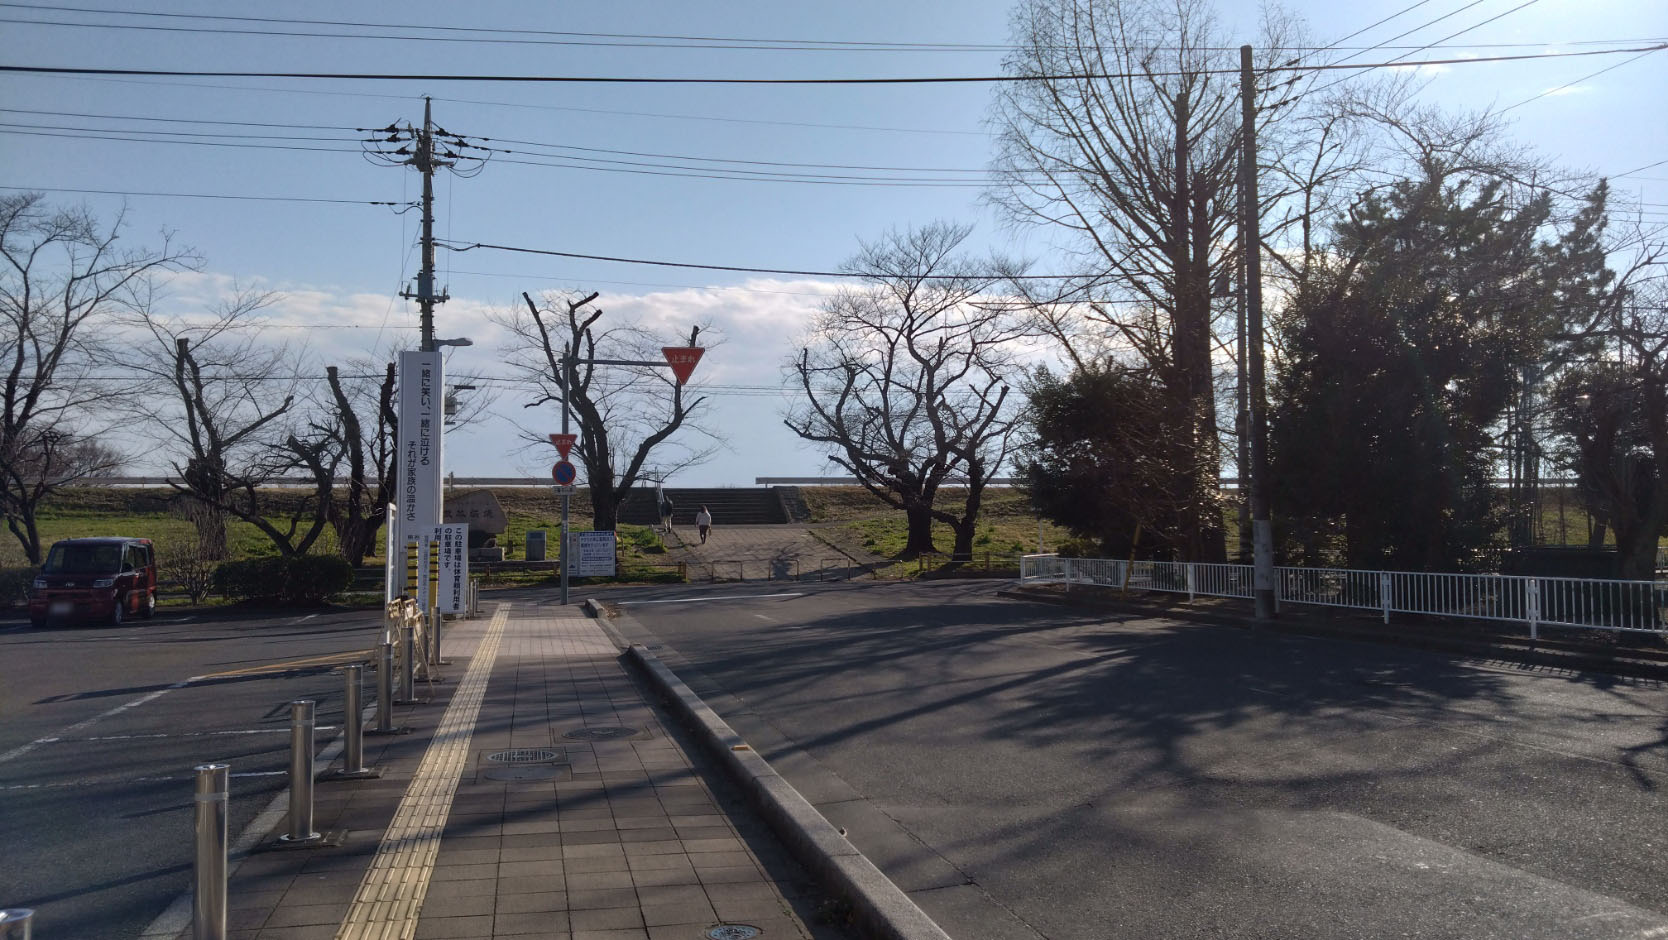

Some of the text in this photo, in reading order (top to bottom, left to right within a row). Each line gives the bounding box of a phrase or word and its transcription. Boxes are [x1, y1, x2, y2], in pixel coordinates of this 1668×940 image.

[420, 362, 432, 466] 一緒に笑い、一緒に泣ける
[406, 440, 417, 521] それが家族の温かさ
